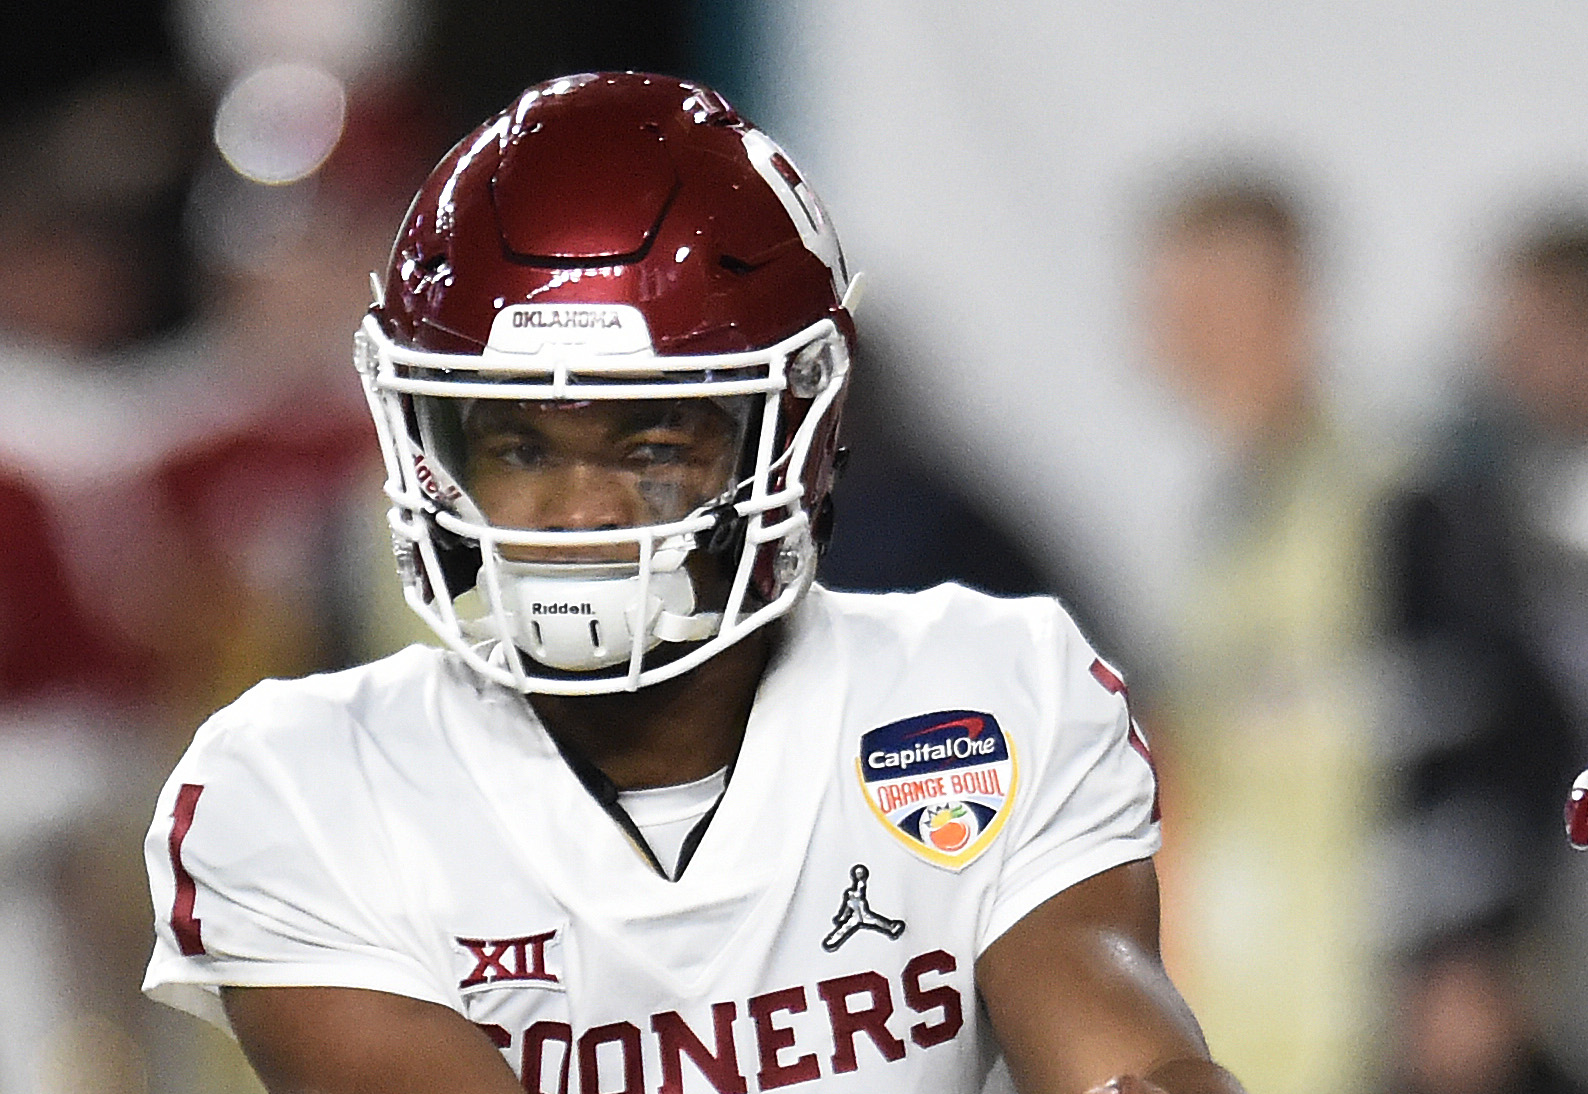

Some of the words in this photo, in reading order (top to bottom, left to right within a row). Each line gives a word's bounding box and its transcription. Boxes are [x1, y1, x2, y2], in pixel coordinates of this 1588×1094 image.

[513, 311, 622, 328] OKLAHOMA
[532, 602, 592, 615] Riddell
[877, 777, 947, 814] ORANGE
[951, 768, 1005, 796] BOWL
[457, 928, 560, 990] XII
